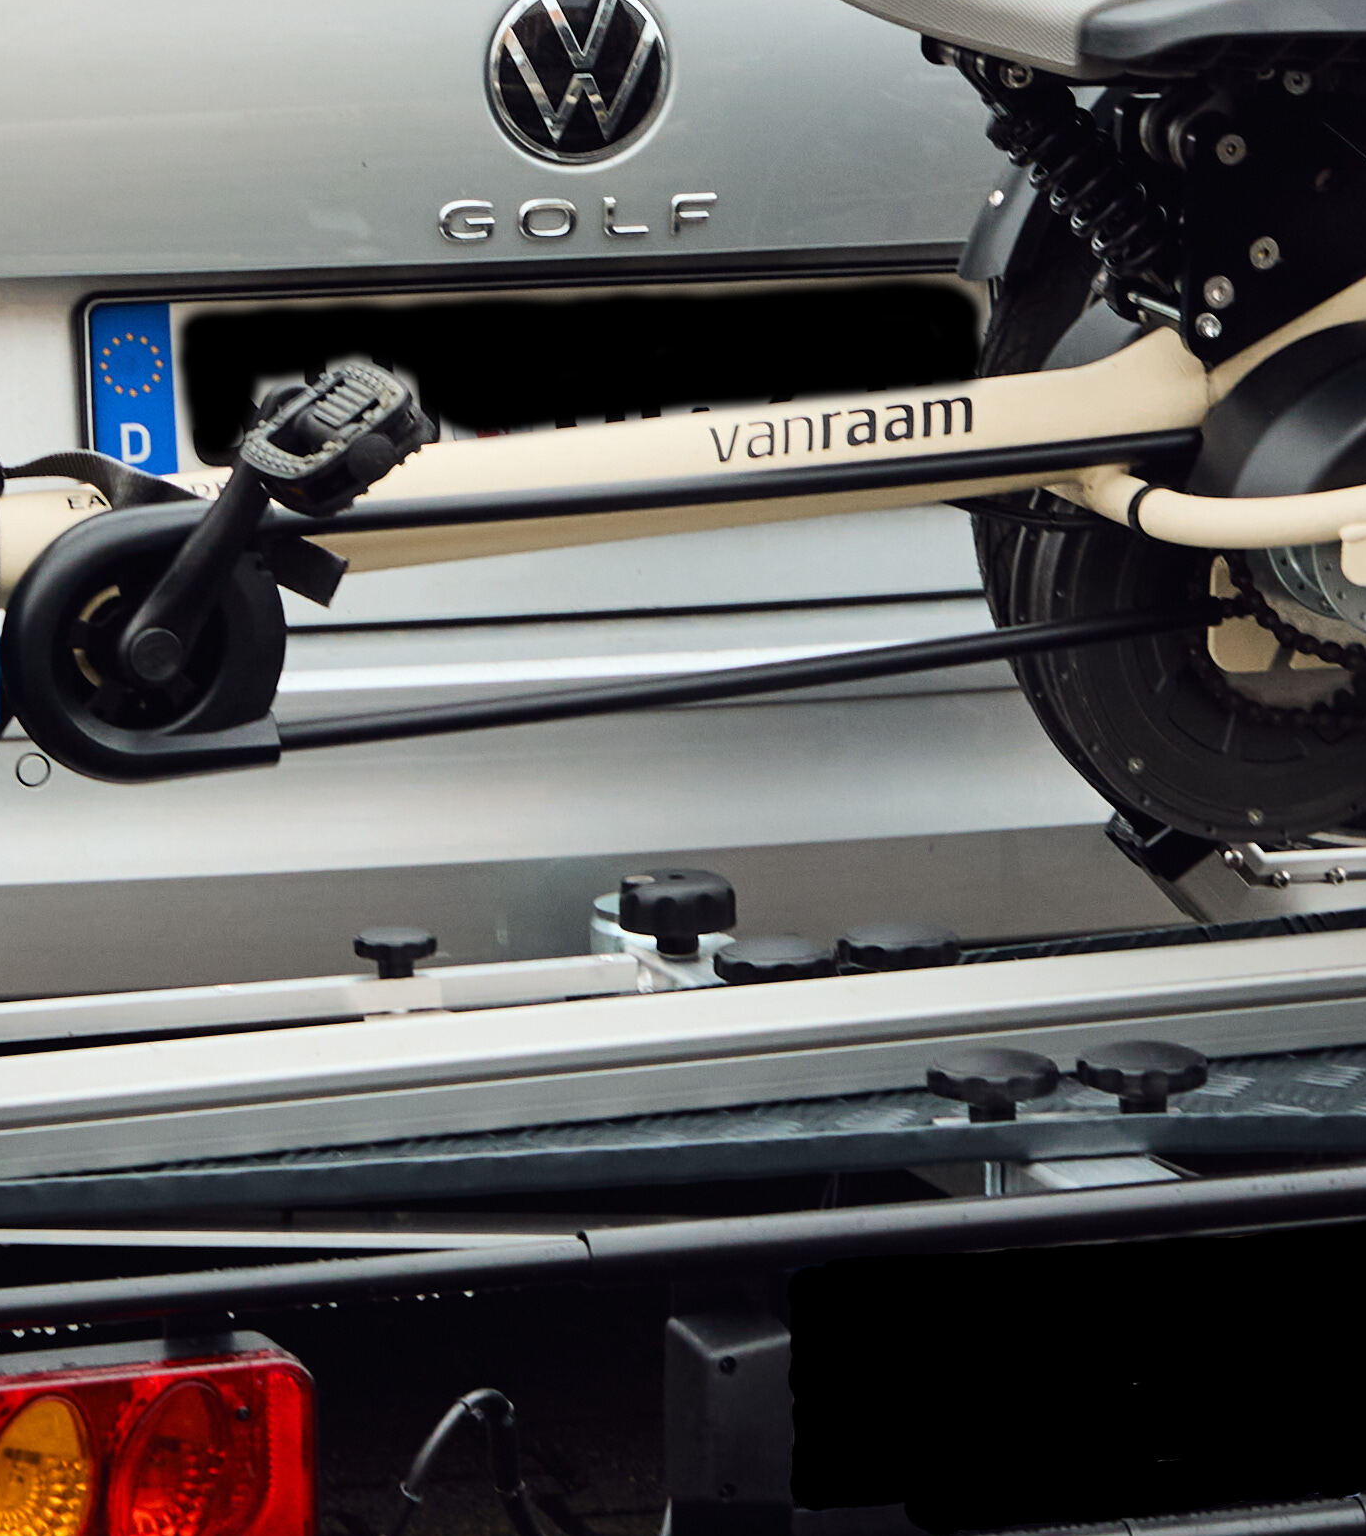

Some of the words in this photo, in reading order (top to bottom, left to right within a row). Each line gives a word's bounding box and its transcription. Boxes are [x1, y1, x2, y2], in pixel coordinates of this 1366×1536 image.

[438, 192, 718, 241] GOLF
[120, 422, 152, 465] D
[709, 396, 973, 463] vanraam
